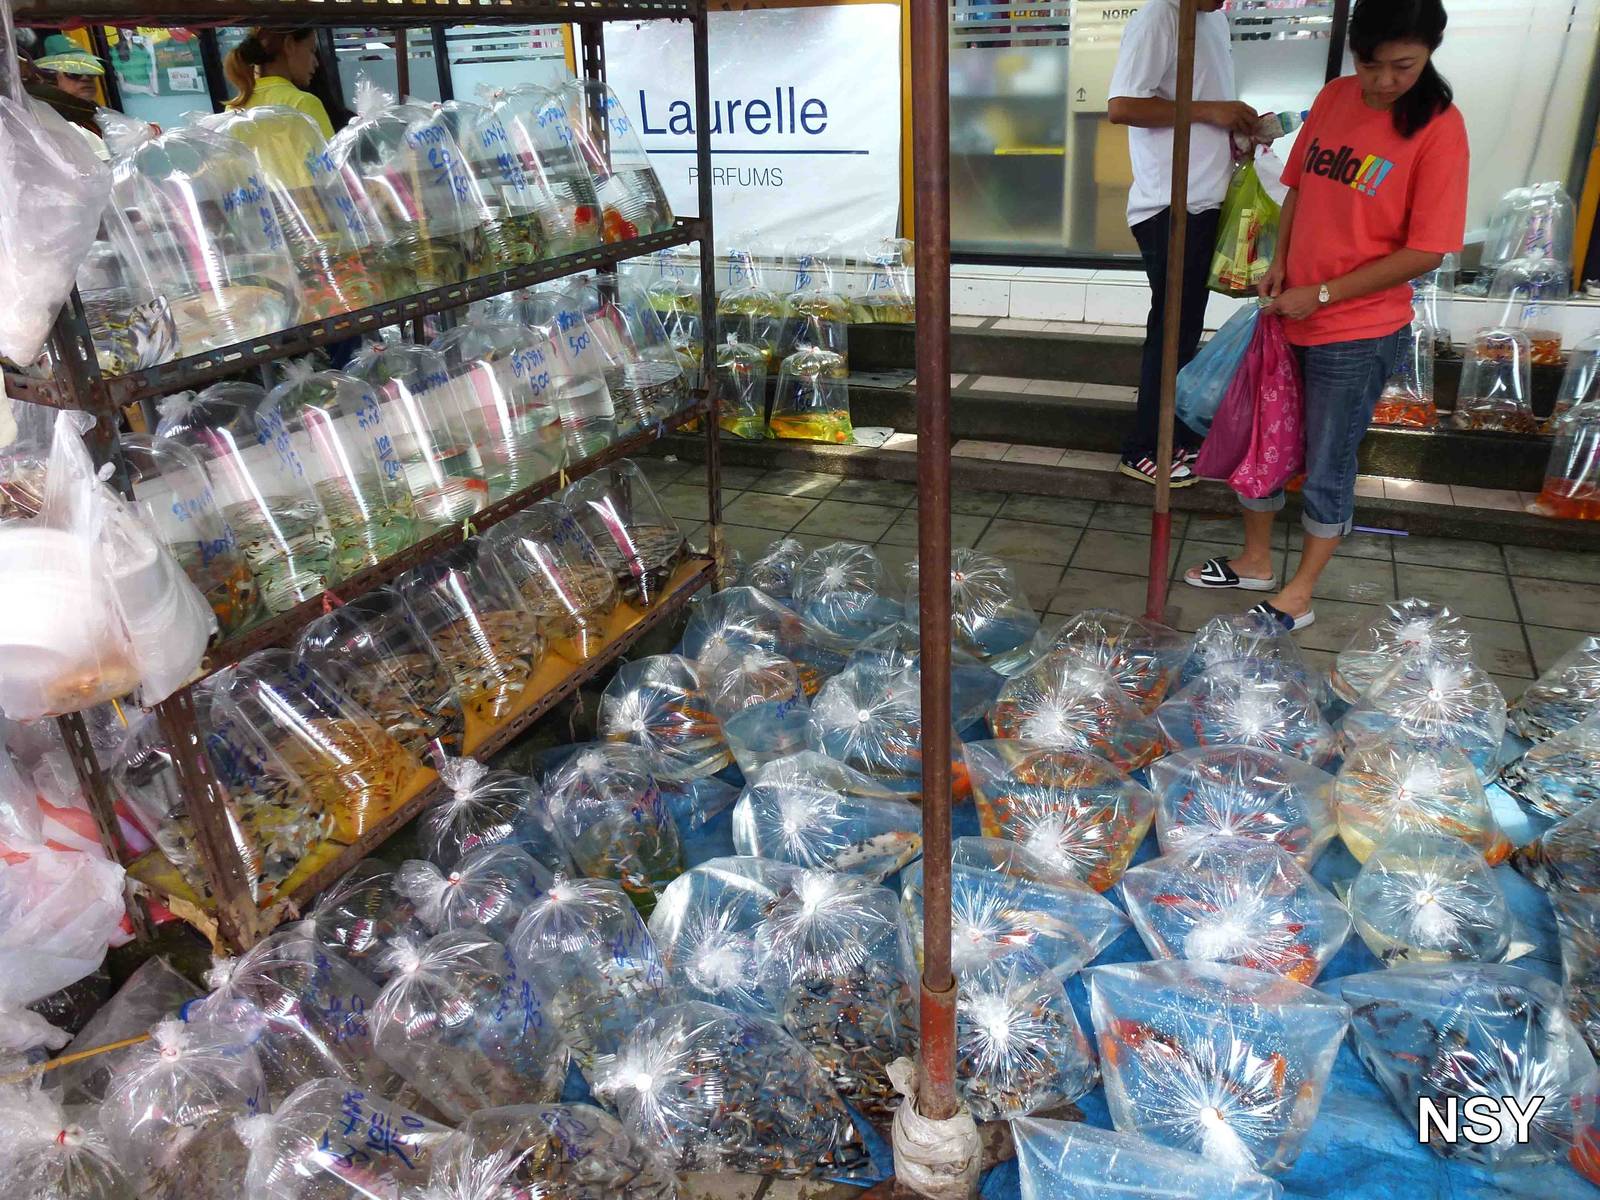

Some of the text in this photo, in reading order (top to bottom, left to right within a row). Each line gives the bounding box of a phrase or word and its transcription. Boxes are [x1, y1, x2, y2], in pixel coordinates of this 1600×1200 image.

[638, 86, 828, 136] Laurelle
[688, 167, 784, 188] PRFUMS
[530, 371, 550, 396] 500
